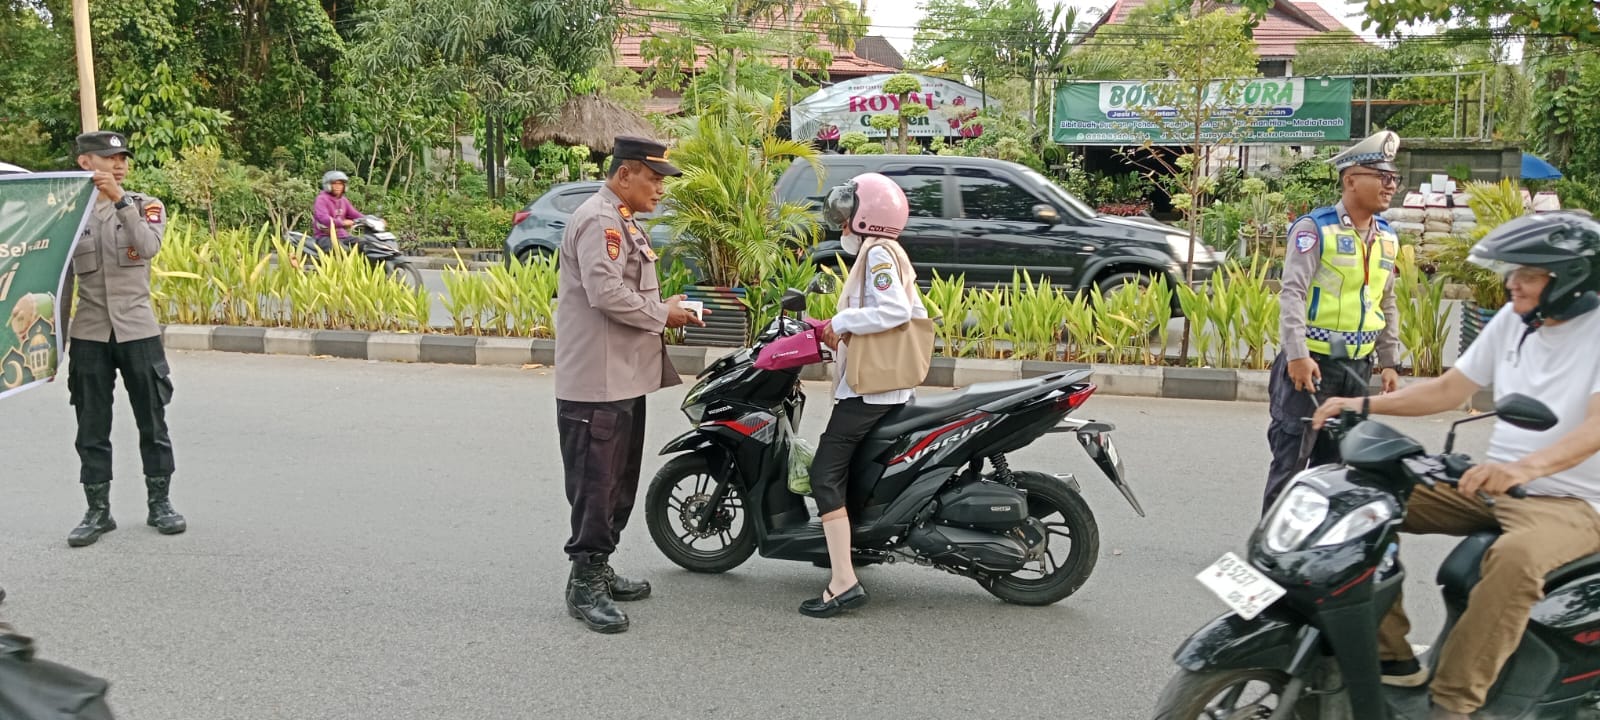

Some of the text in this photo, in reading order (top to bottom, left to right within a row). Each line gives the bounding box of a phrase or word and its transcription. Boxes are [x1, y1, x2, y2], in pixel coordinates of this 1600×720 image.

[860, 114, 930, 127] Gen
[1293, 118, 1318, 127] Media
[1318, 117, 1344, 127] Tanah
[708, 405, 733, 415] HONDA
[904, 421, 990, 464] VARIO
